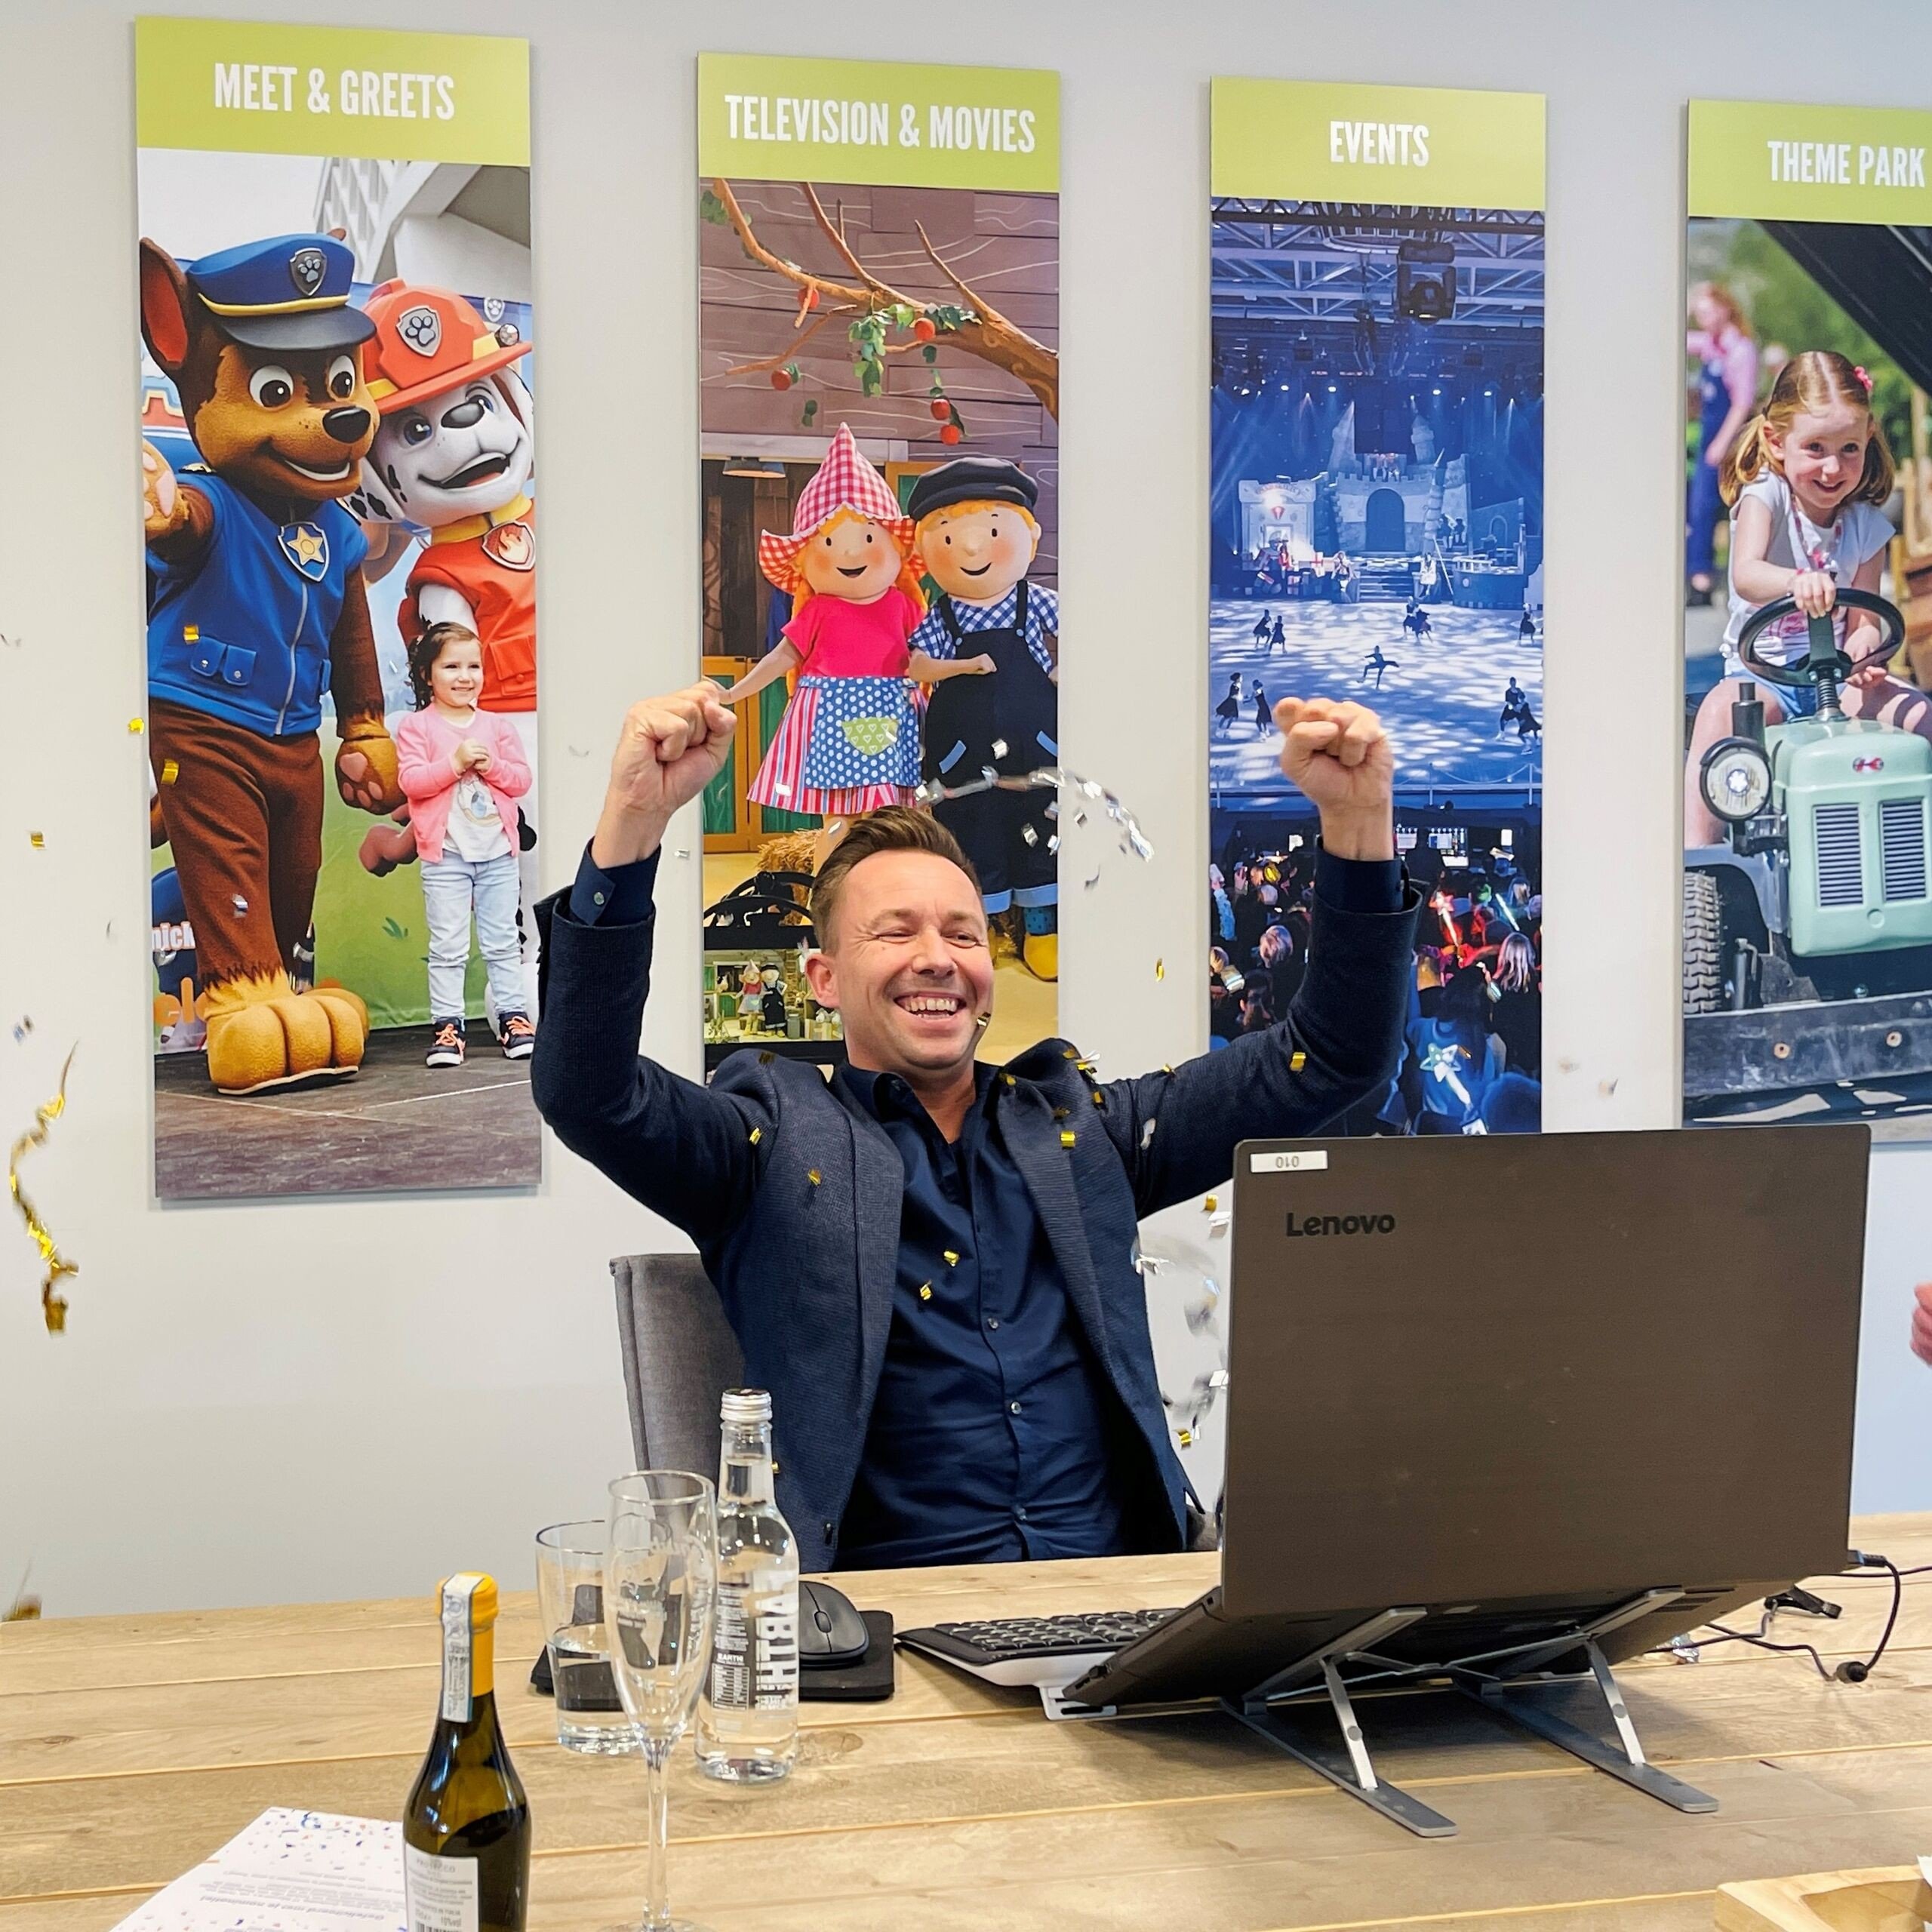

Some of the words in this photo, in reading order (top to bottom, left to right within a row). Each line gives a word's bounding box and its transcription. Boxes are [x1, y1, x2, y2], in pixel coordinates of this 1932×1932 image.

[214, 63, 298, 112] MEET
[307, 68, 331, 114] &
[341, 69, 455, 121] GREETS
[724, 94, 889, 146] TELEVISION
[899, 103, 920, 148] &
[930, 105, 1035, 153] MOVIES
[1330, 121, 1429, 167] EVENTS
[1767, 140, 1851, 184] THEME
[1859, 145, 1926, 188] PARK
[1275, 1155, 1300, 1169] 010
[1286, 1212, 1395, 1237] Lenovo
